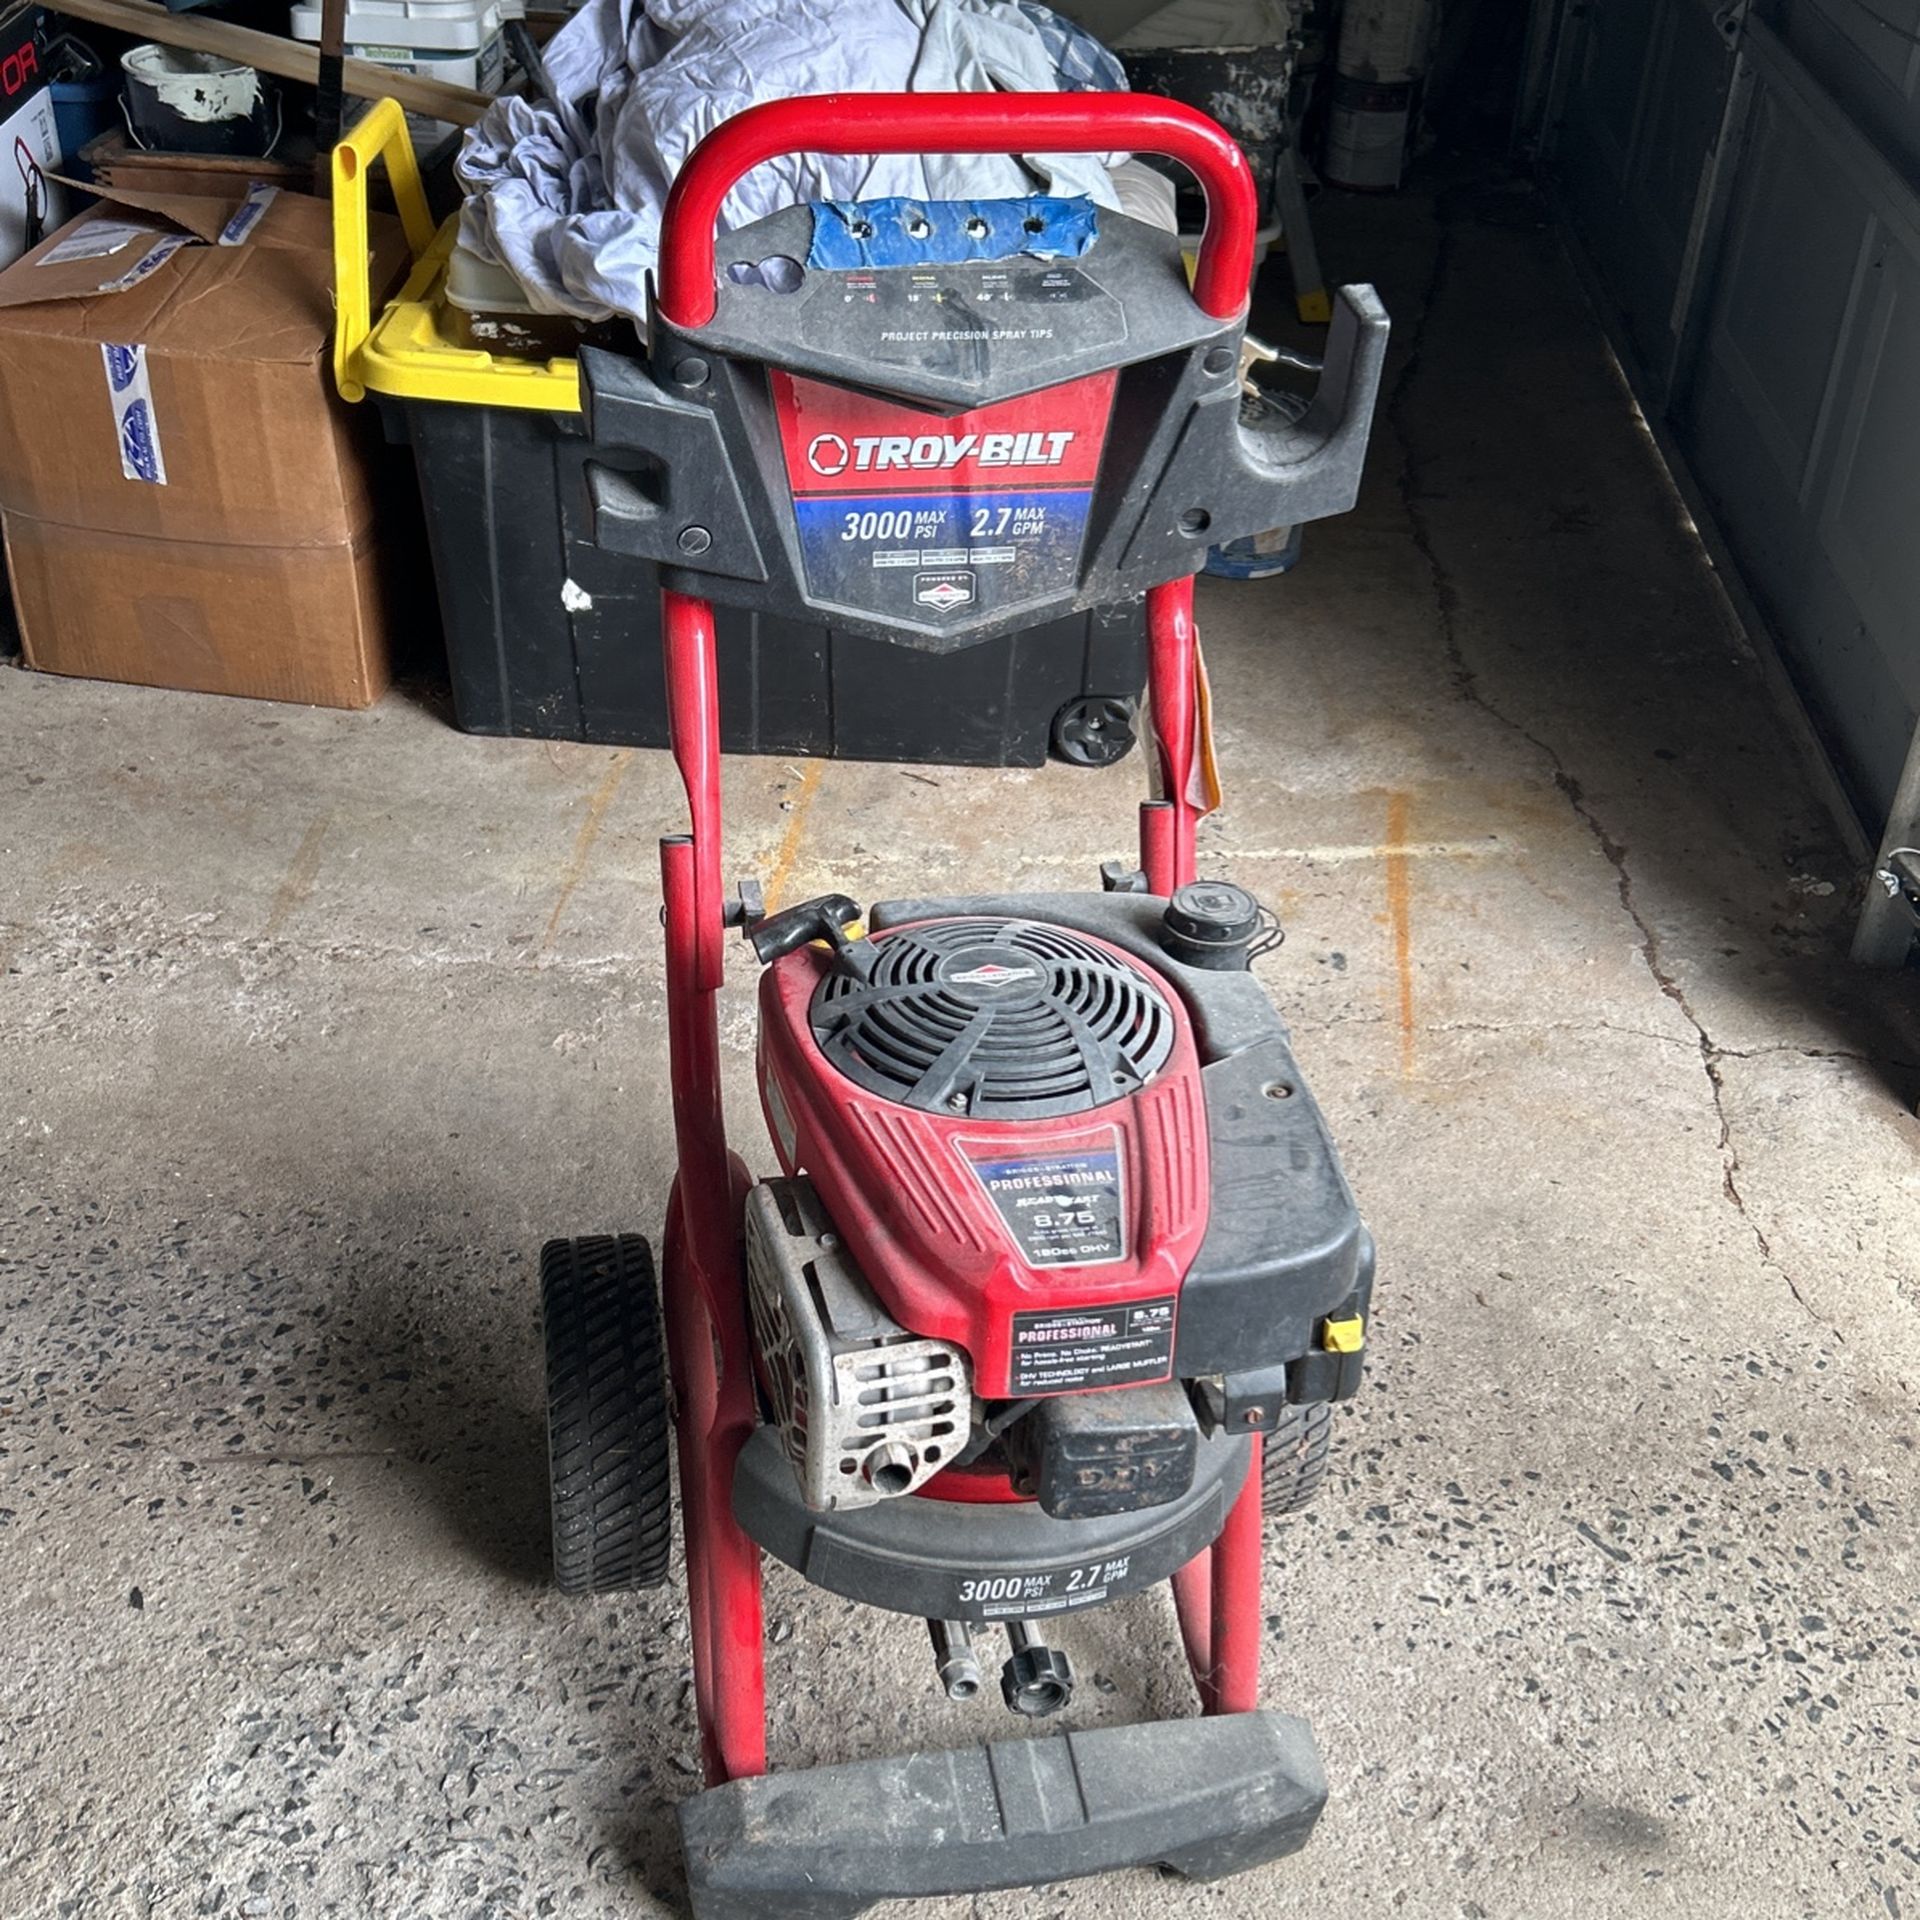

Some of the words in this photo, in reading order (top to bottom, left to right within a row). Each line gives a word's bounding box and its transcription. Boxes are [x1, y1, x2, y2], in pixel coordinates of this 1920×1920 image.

[0, 40, 39, 96] OR
[881, 331, 929, 342] PROJECT
[931, 330, 989, 341] PRECISION
[993, 329, 1027, 340] SPRAY
[1030, 328, 1054, 339] TIPS
[853, 431, 1075, 471] TROY-BILT
[914, 509, 948, 525] MAX
[1014, 506, 1047, 521] MAX
[841, 509, 913, 541] 3000
[970, 507, 1014, 538] 2.7
[1012, 521, 1045, 536] GPM
[914, 525, 938, 540] PSI
[990, 1170, 1116, 1191] PROFESSIONAL
[1033, 1210, 1096, 1227] 8.75
[1079, 1243, 1111, 1255] OHV
[1018, 1324, 1118, 1343] PROFESSIONAL
[1104, 1556, 1131, 1573] MAX
[1023, 1575, 1053, 1588] MAX
[1066, 1564, 1103, 1592] 2.7
[1102, 1567, 1130, 1584] GPM
[959, 1577, 1022, 1602] 3000
[1023, 1587, 1044, 1599] PSI
